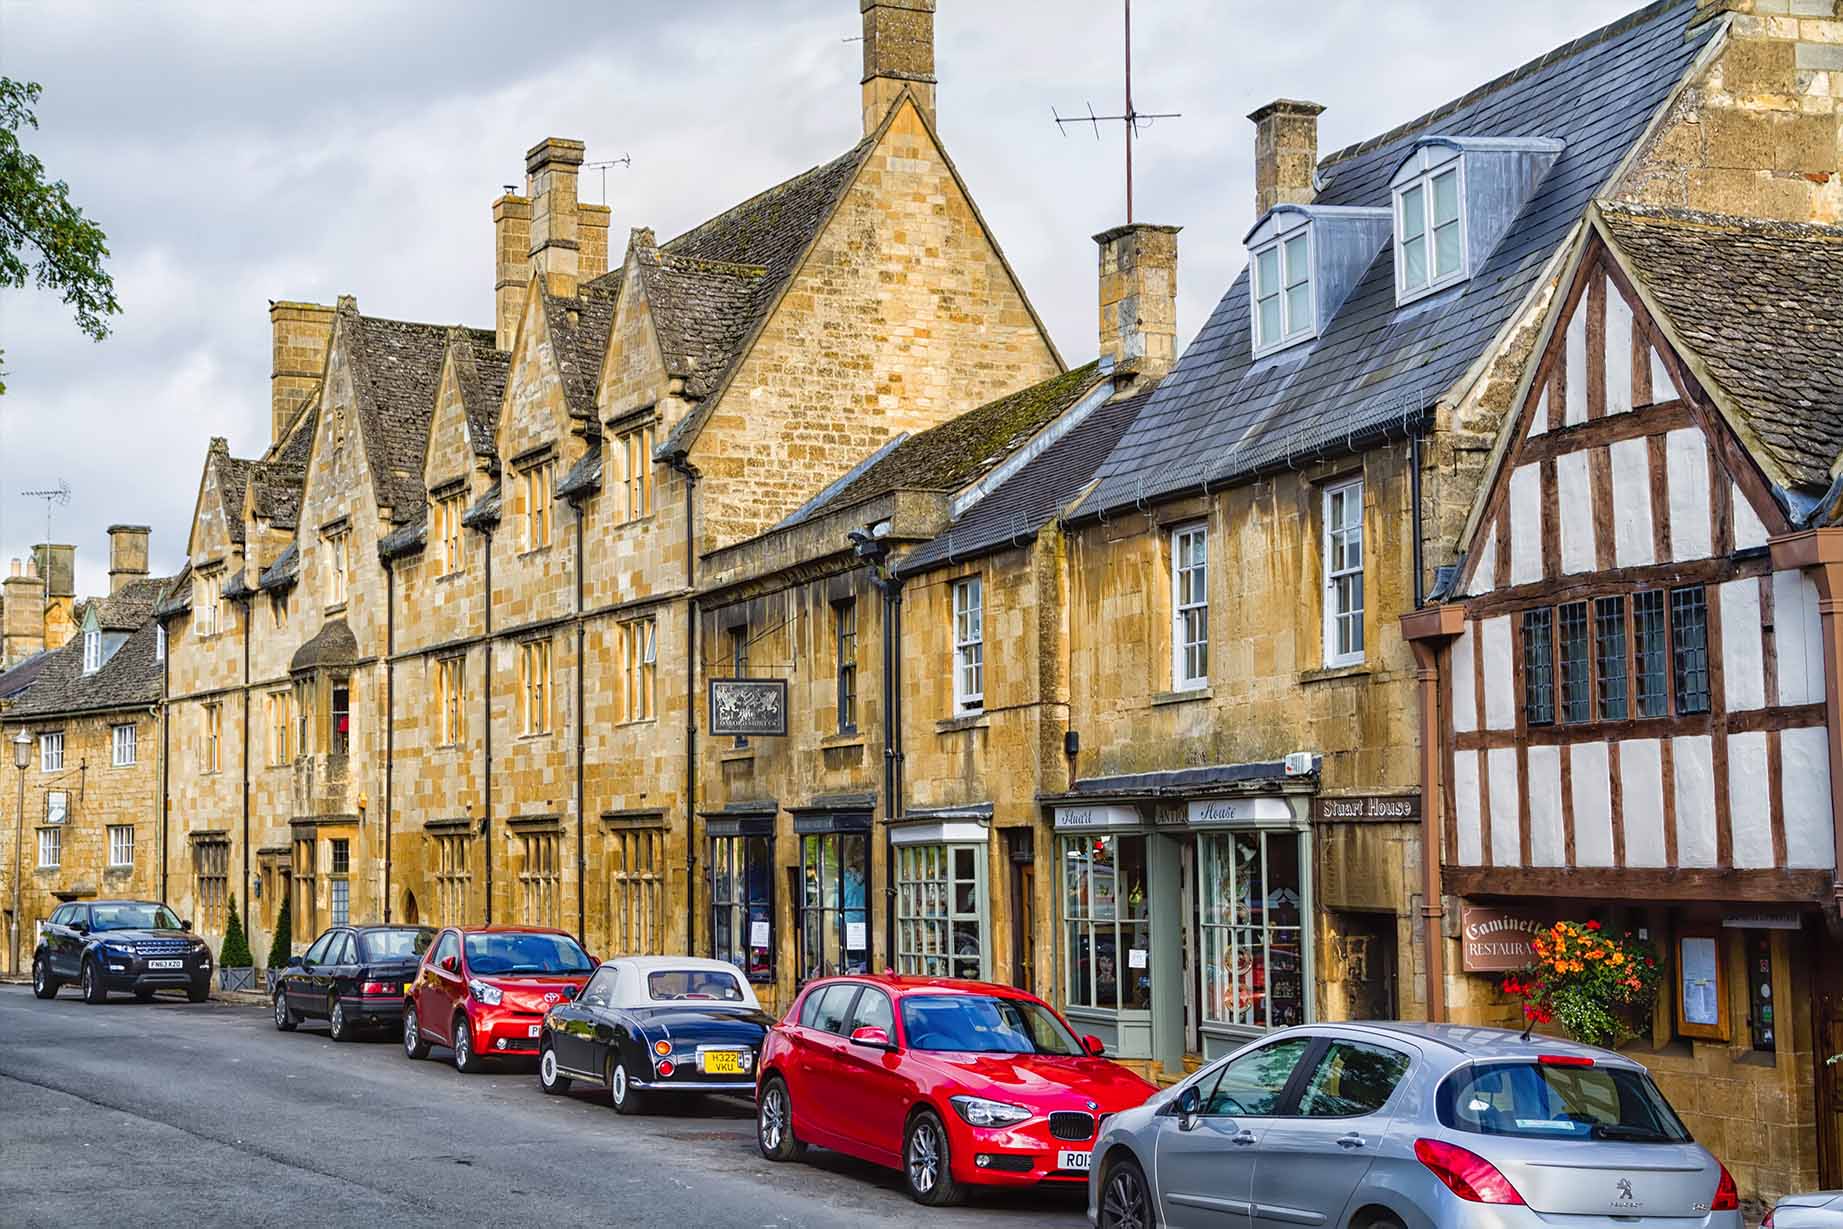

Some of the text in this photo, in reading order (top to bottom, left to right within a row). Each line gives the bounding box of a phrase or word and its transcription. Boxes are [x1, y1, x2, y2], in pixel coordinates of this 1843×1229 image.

[1200, 801, 1236, 820] House
[1323, 798, 1411, 817] Stuart House
[1062, 809, 1092, 825] Stuart
[1469, 942, 1534, 956] RESTAURA
[532, 1026, 541, 1036] P
[712, 1053, 737, 1063] H322
[715, 1063, 734, 1072] VKU
